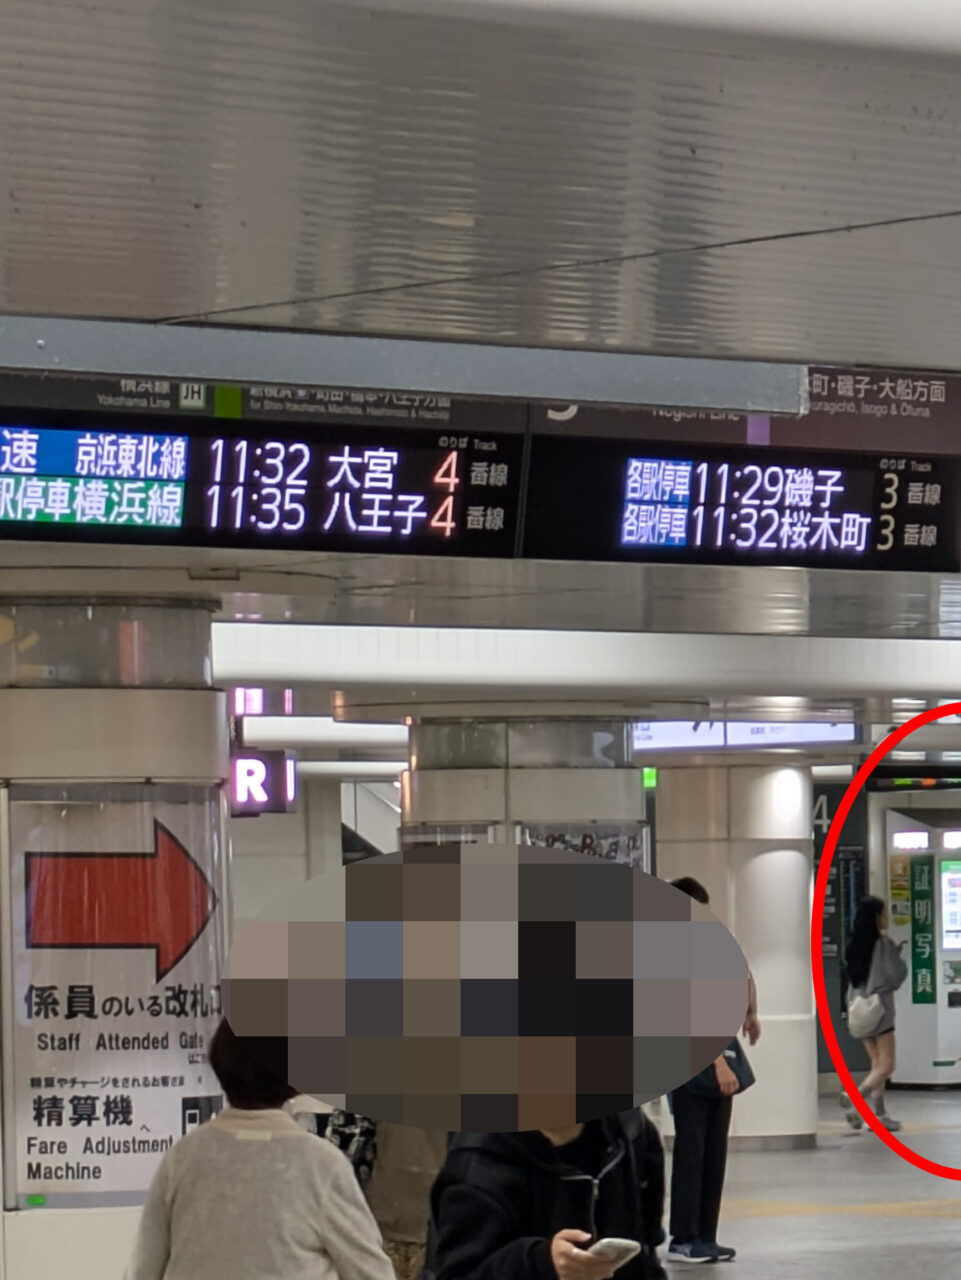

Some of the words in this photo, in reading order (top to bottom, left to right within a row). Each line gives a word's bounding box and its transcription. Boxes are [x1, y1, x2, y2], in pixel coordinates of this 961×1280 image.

[809, 373, 946, 402] 町・磯子・大船方面
[75, 433, 187, 480] 京浜東北線
[211, 438, 310, 486] 11:32
[327, 445, 399, 490] 大宮
[433, 451, 460, 493] 4
[470, 462, 508, 487] 番線
[880, 472, 899, 510] 3
[907, 482, 942, 506] 番線
[207, 485, 305, 530] 11:35
[323, 491, 428, 535] 八王子
[430, 495, 456, 537] 4
[466, 506, 505, 531] 番線
[876, 514, 896, 550] 3
[903, 523, 938, 547] 番線
[914, 865, 933, 993] 証明写真
[36, 1033, 81, 1051] Staff
[95, 1031, 169, 1050] Attended
[26, 1136, 68, 1155] Fare
[82, 1135, 174, 1156] Adjustment
[26, 1162, 103, 1180] Machine
